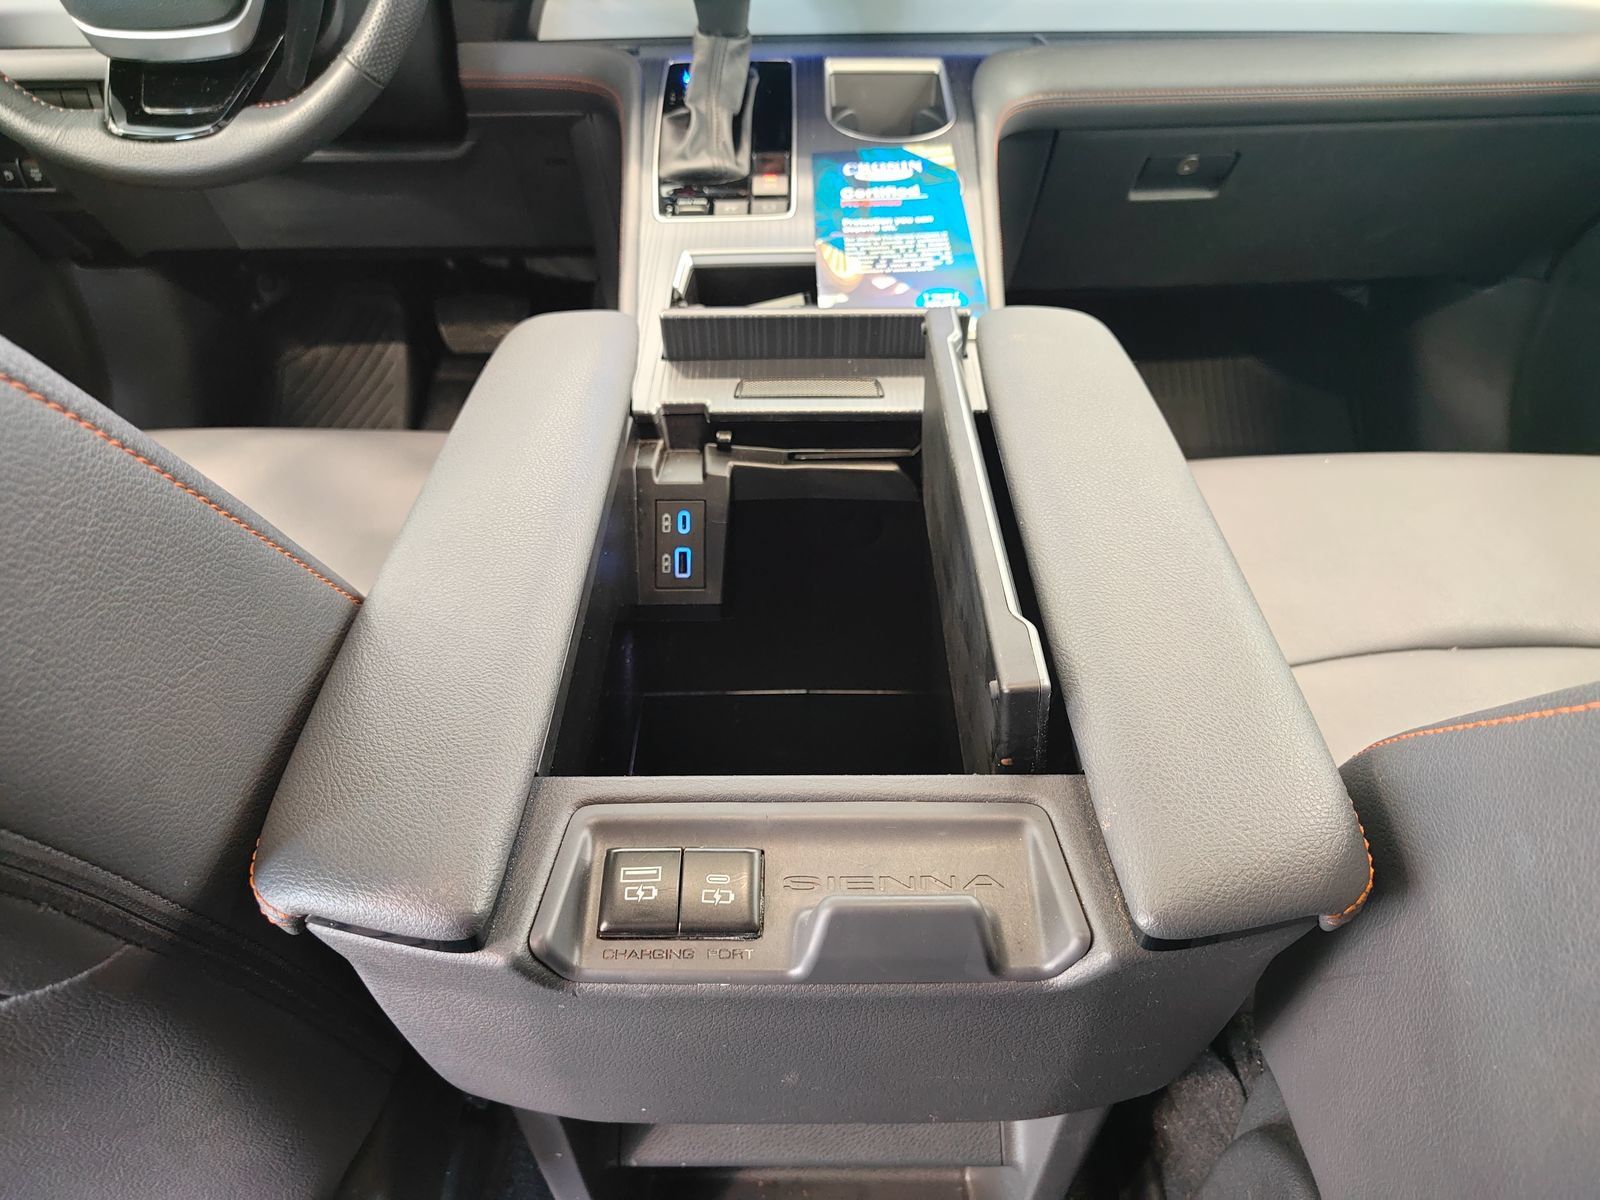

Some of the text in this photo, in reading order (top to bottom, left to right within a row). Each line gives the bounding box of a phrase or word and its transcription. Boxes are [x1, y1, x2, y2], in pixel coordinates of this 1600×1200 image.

[783, 874, 1005, 891] SIENNA
[602, 948, 754, 960] CHARGING PORT
